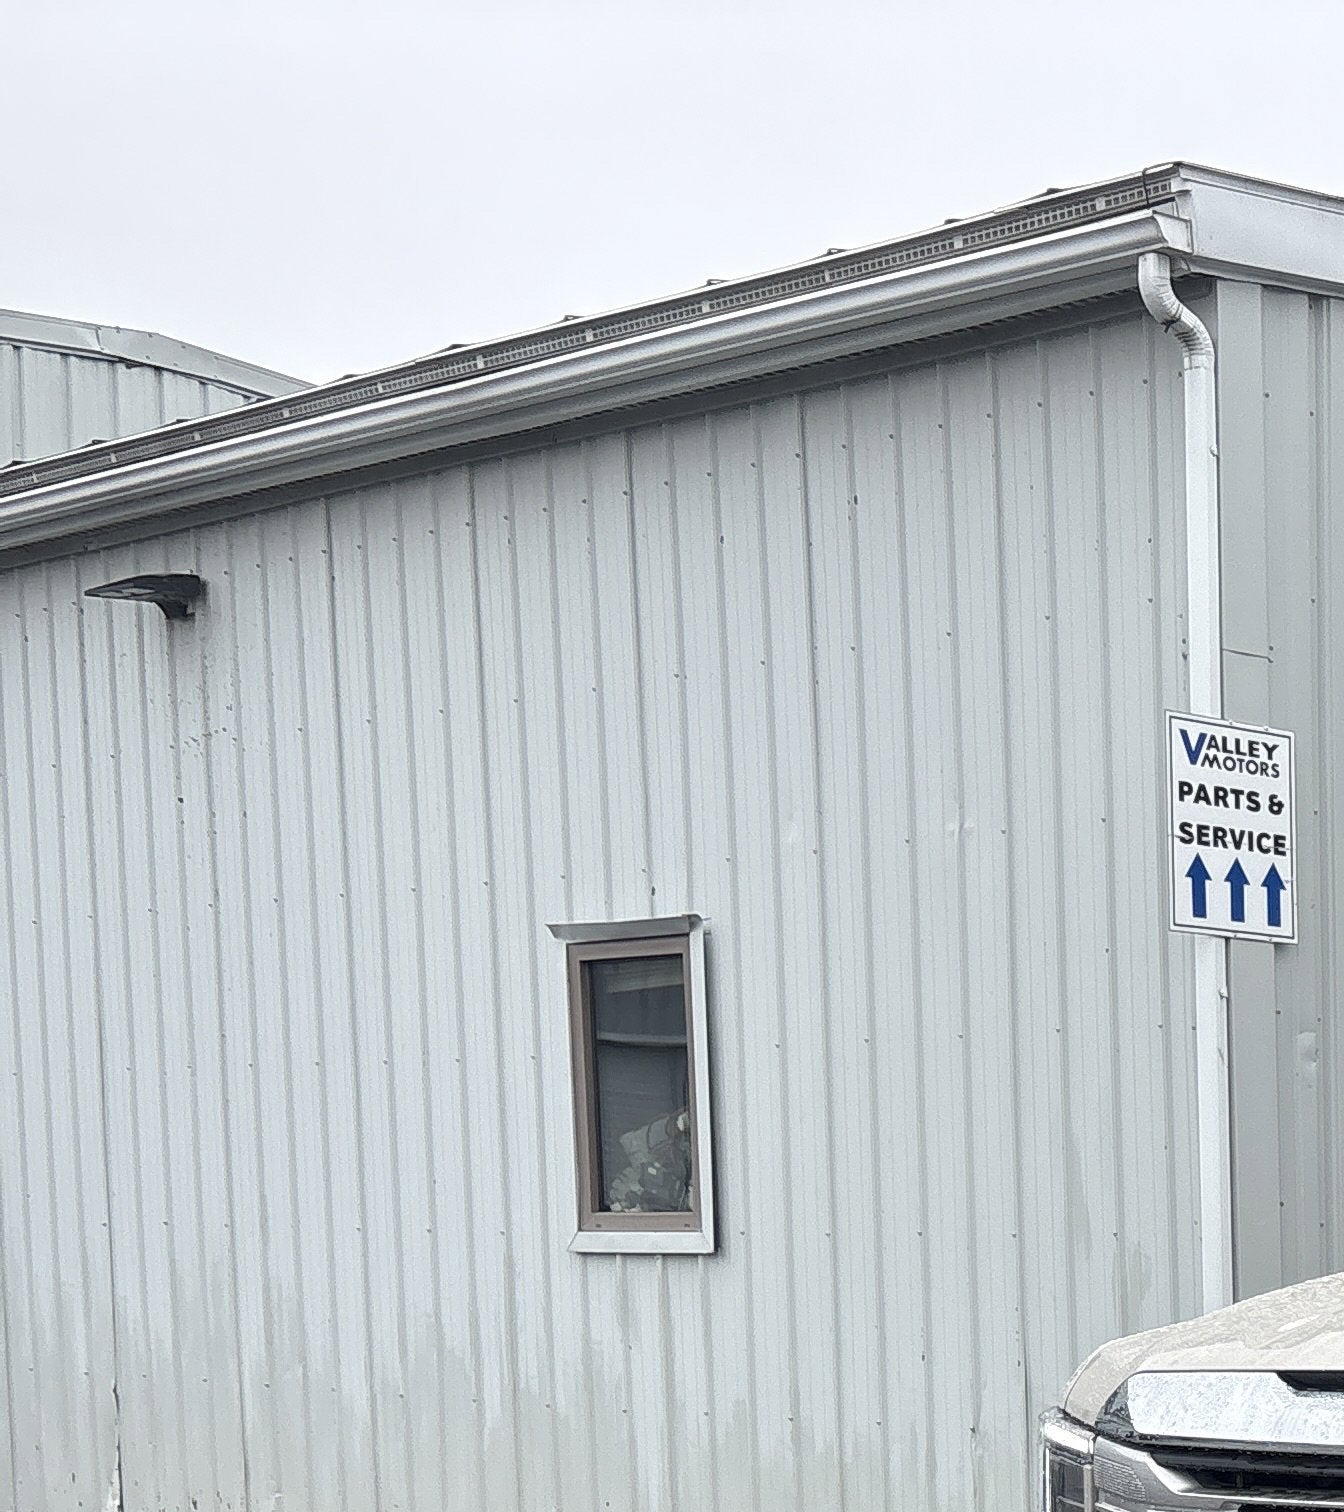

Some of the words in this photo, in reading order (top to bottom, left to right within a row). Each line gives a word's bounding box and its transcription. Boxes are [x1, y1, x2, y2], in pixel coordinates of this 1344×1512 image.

[1178, 728, 1280, 766] VALLEY
[1200, 753, 1280, 779] MOTORS
[1178, 781, 1261, 813] PARTS
[1267, 794, 1285, 816] &
[1178, 821, 1287, 857] SERVICE
